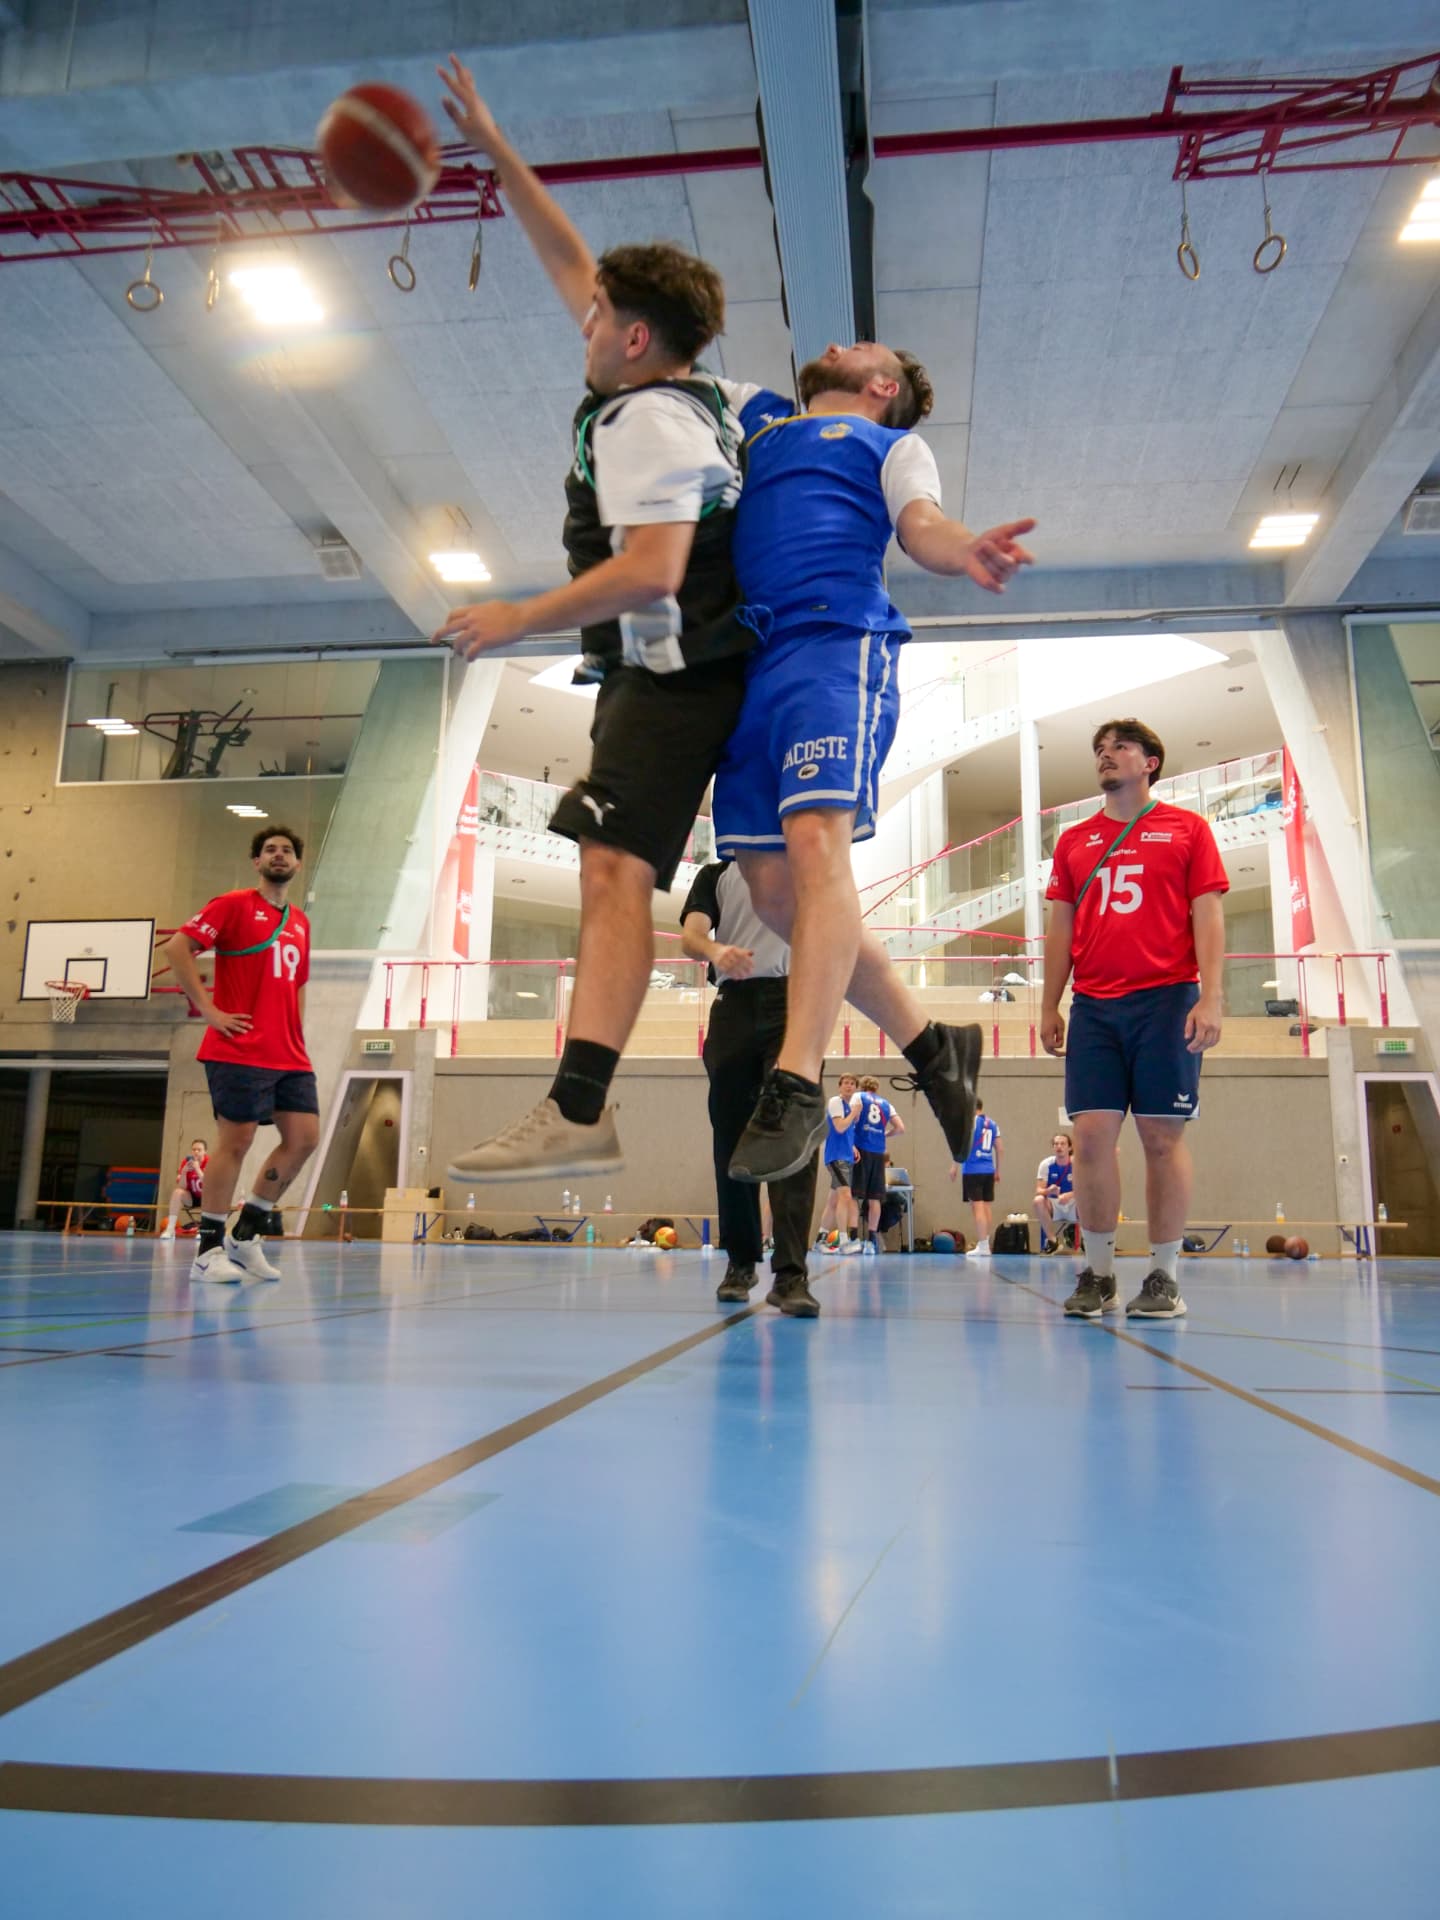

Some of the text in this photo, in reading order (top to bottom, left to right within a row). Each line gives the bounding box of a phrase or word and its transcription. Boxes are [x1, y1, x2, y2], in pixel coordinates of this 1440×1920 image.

[1096, 864, 1144, 916] 15
[272, 940, 300, 981] 19
[868, 1103, 881, 1124] 8
